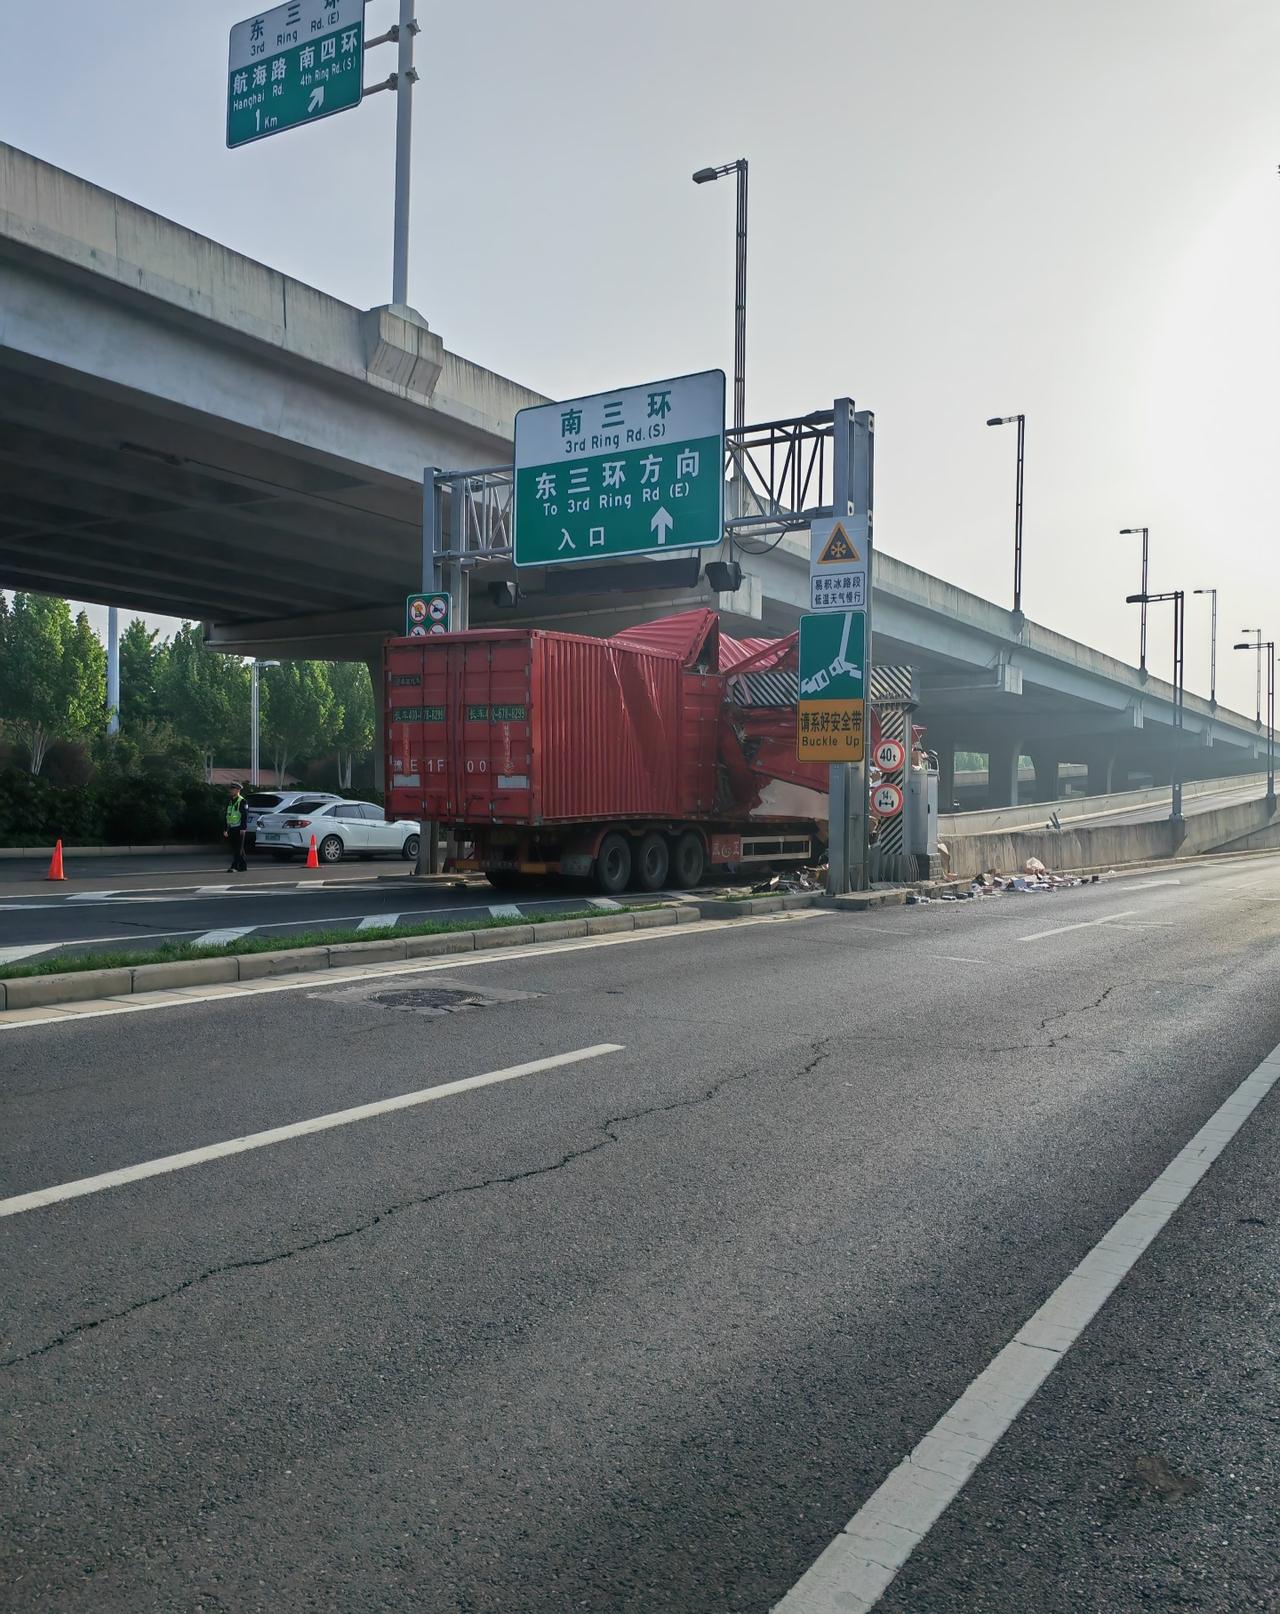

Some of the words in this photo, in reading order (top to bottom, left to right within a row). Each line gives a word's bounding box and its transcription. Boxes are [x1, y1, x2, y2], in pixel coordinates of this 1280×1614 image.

[250, 41, 265, 56] 3rd
[276, 30, 298, 46] Ring
[233, 57, 287, 95] 航海路
[299, 29, 358, 71] 南四环
[233, 87, 265, 111] Hanghai
[300, 72, 312, 86] 4th
[314, 68, 329, 82] Ring
[560, 390, 672, 438] 南三环
[565, 438, 586, 453] 3rd
[591, 433, 620, 449] Ring
[535, 448, 700, 500] 东三环方向
[543, 503, 558, 516] To
[567, 498, 590, 513] 3rd
[599, 493, 632, 510] Ring
[558, 526, 605, 551] 入口
[815, 576, 861, 591] 易积冰路段
[814, 591, 861, 605] 低温天气慢行
[800, 710, 862, 732] 请系好安全带
[802, 735, 838, 747] Buckle
[845, 735, 860, 748] Up
